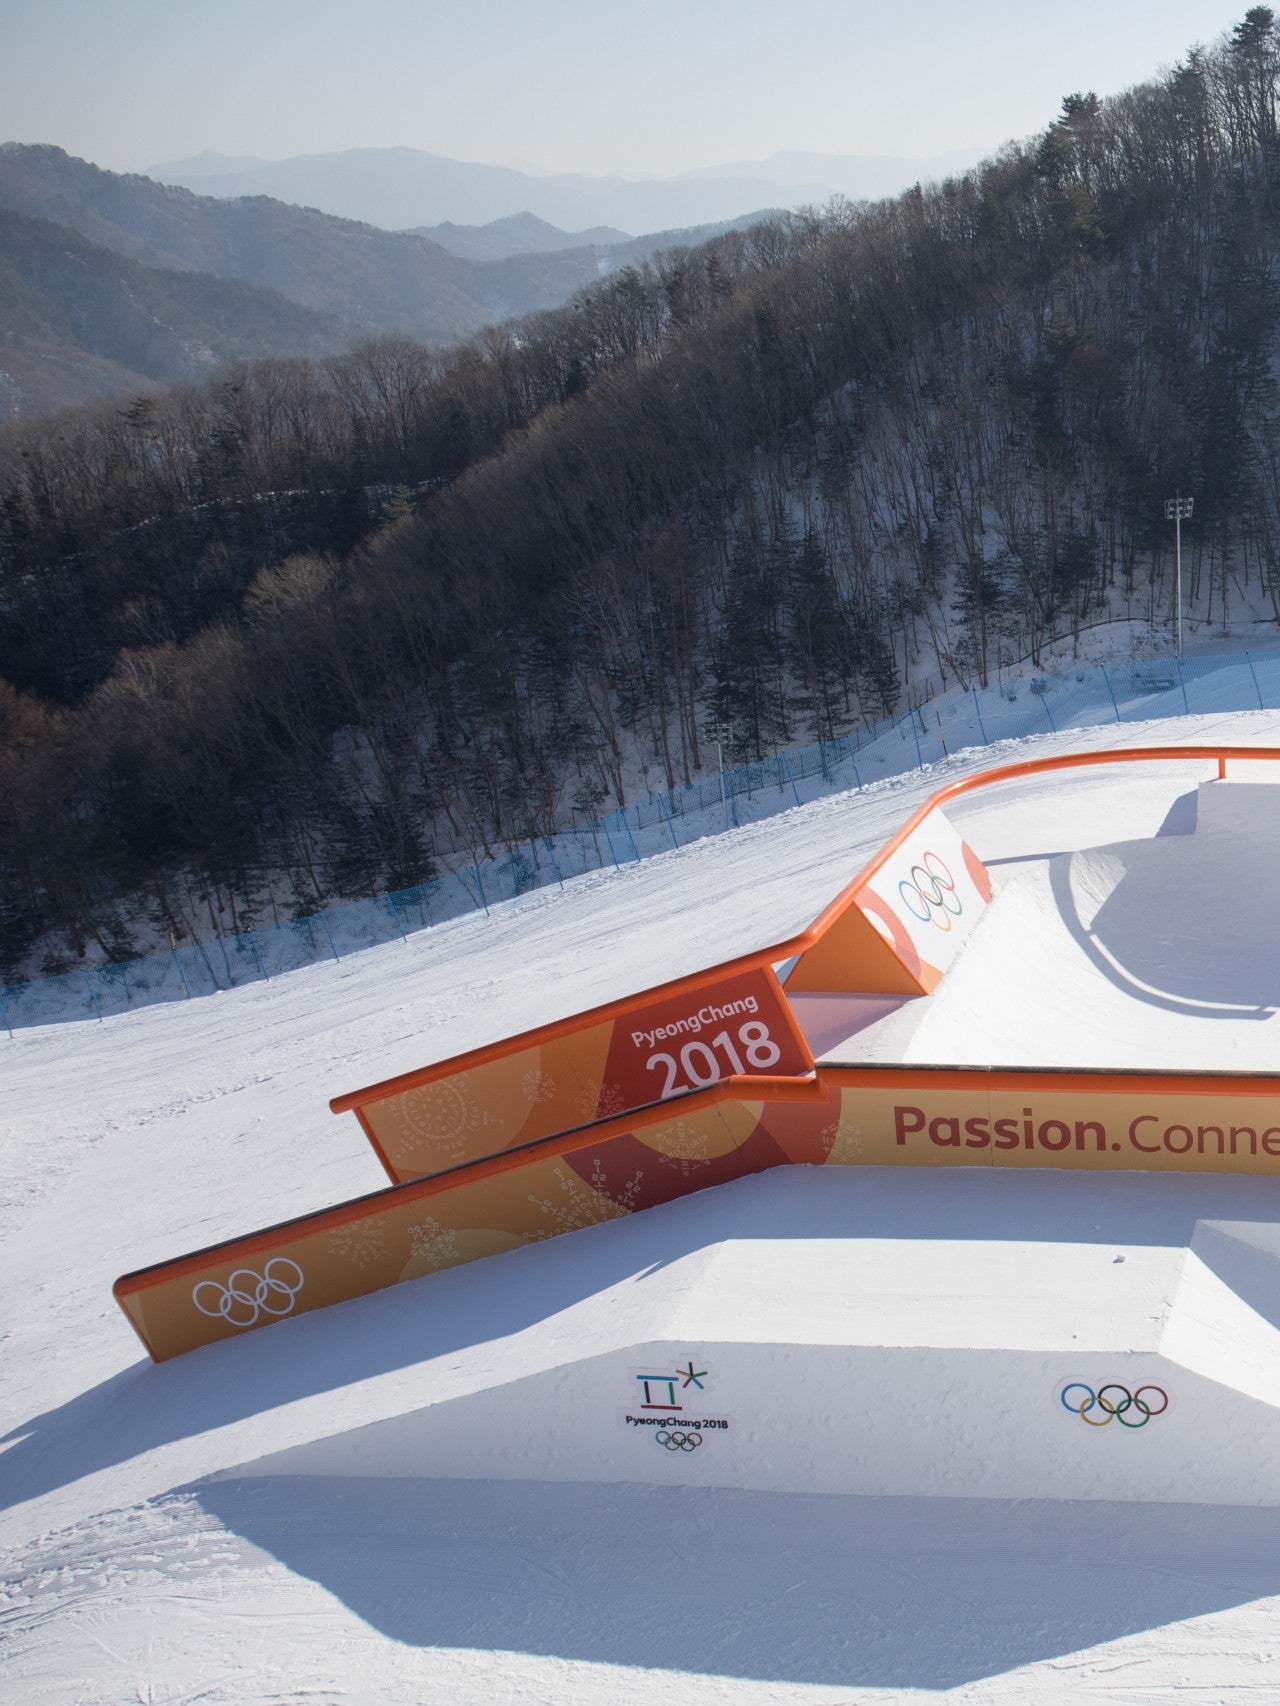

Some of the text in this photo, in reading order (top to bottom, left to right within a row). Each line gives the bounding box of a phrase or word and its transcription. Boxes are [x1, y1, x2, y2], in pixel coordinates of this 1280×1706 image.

[630, 995, 760, 1048] PyeongChang
[646, 1020, 781, 1100] 2018
[892, 1105, 1122, 1153] Passion.
[625, 1415, 728, 1429] PyeongChang 2018
